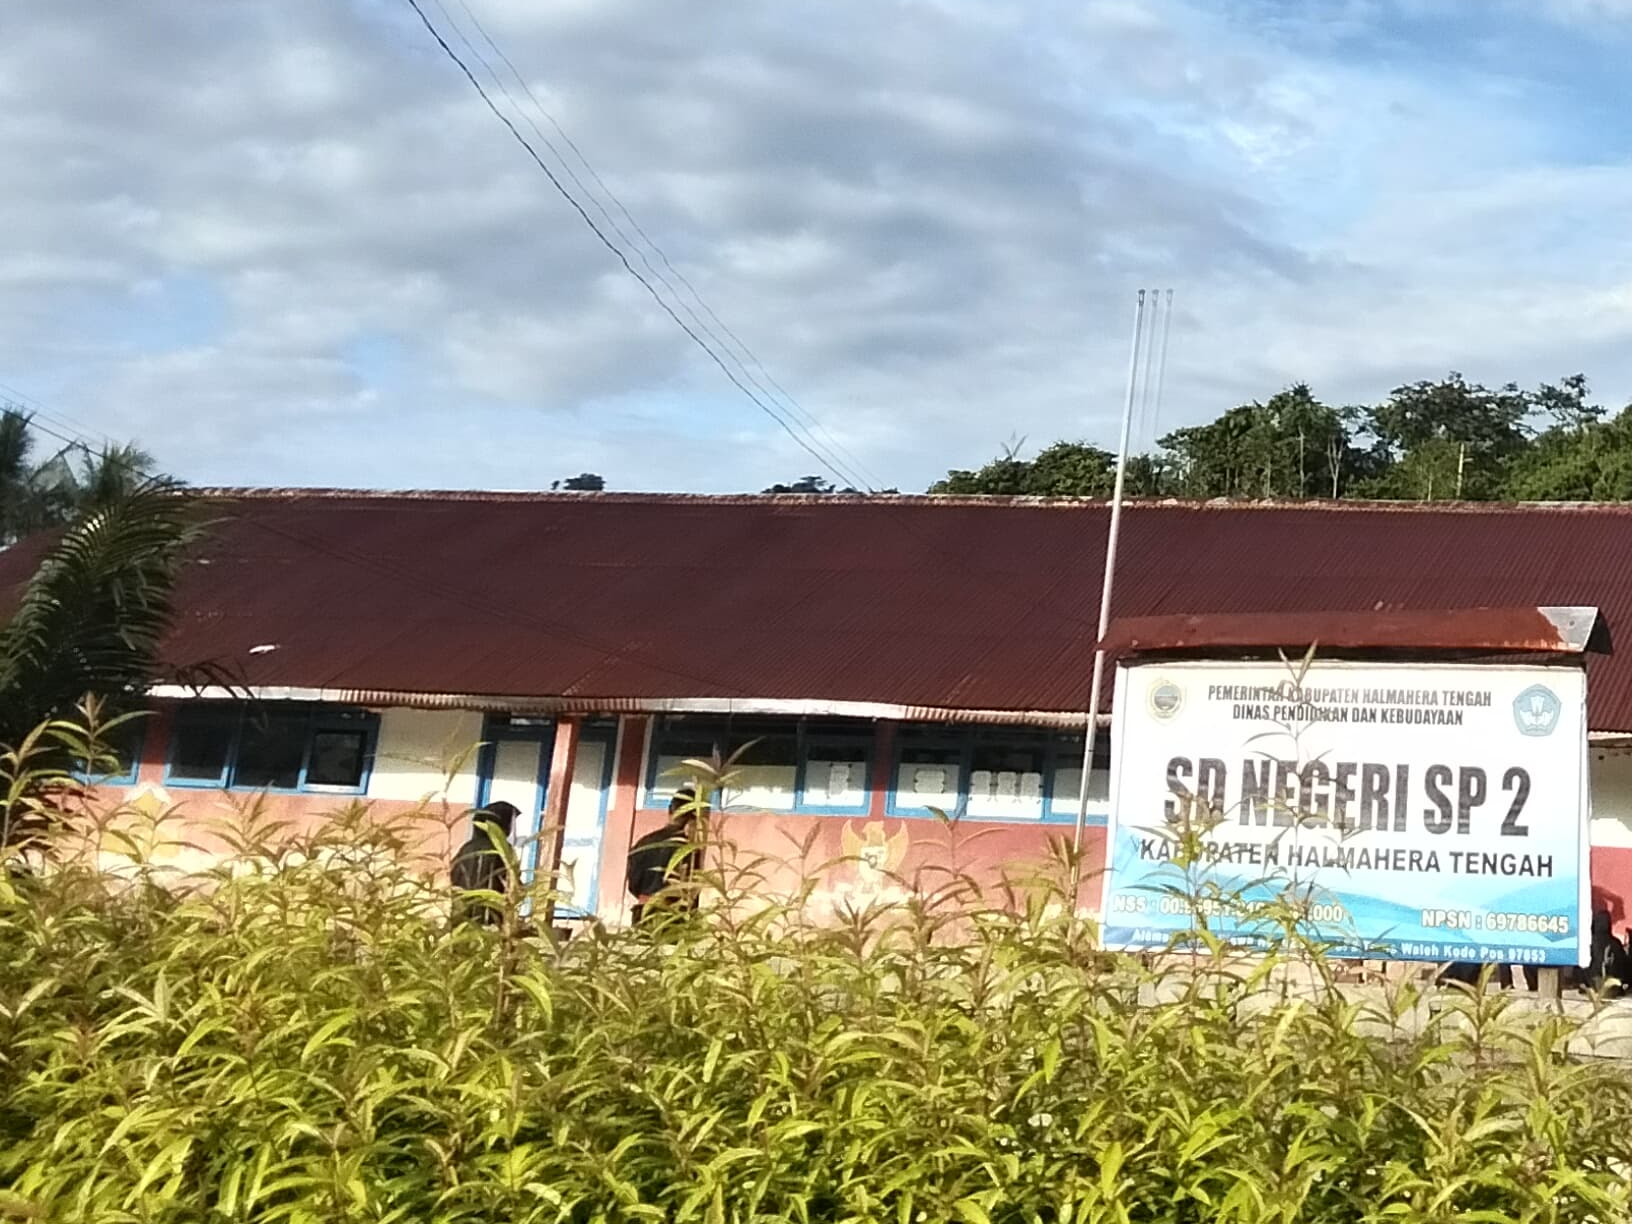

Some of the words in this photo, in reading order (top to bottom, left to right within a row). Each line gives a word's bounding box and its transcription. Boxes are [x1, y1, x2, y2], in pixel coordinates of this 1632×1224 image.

[1362, 688, 1439, 706] HALMAHERA
[1442, 690, 1492, 707] TENGAH
[1232, 704, 1270, 721] DINAS
[1351, 707, 1377, 724] DAN
[1380, 708, 1464, 726] KEBUDAYAAN
[1239, 758, 1409, 833] NEGERI
[1423, 764, 1487, 836] SP
[1500, 766, 1532, 837] 2
[1287, 844, 1441, 874] HALMAHERA
[1449, 851, 1553, 878] TENGAH
[1421, 908, 1472, 930] NPSN
[1485, 911, 1569, 934] 69786645
